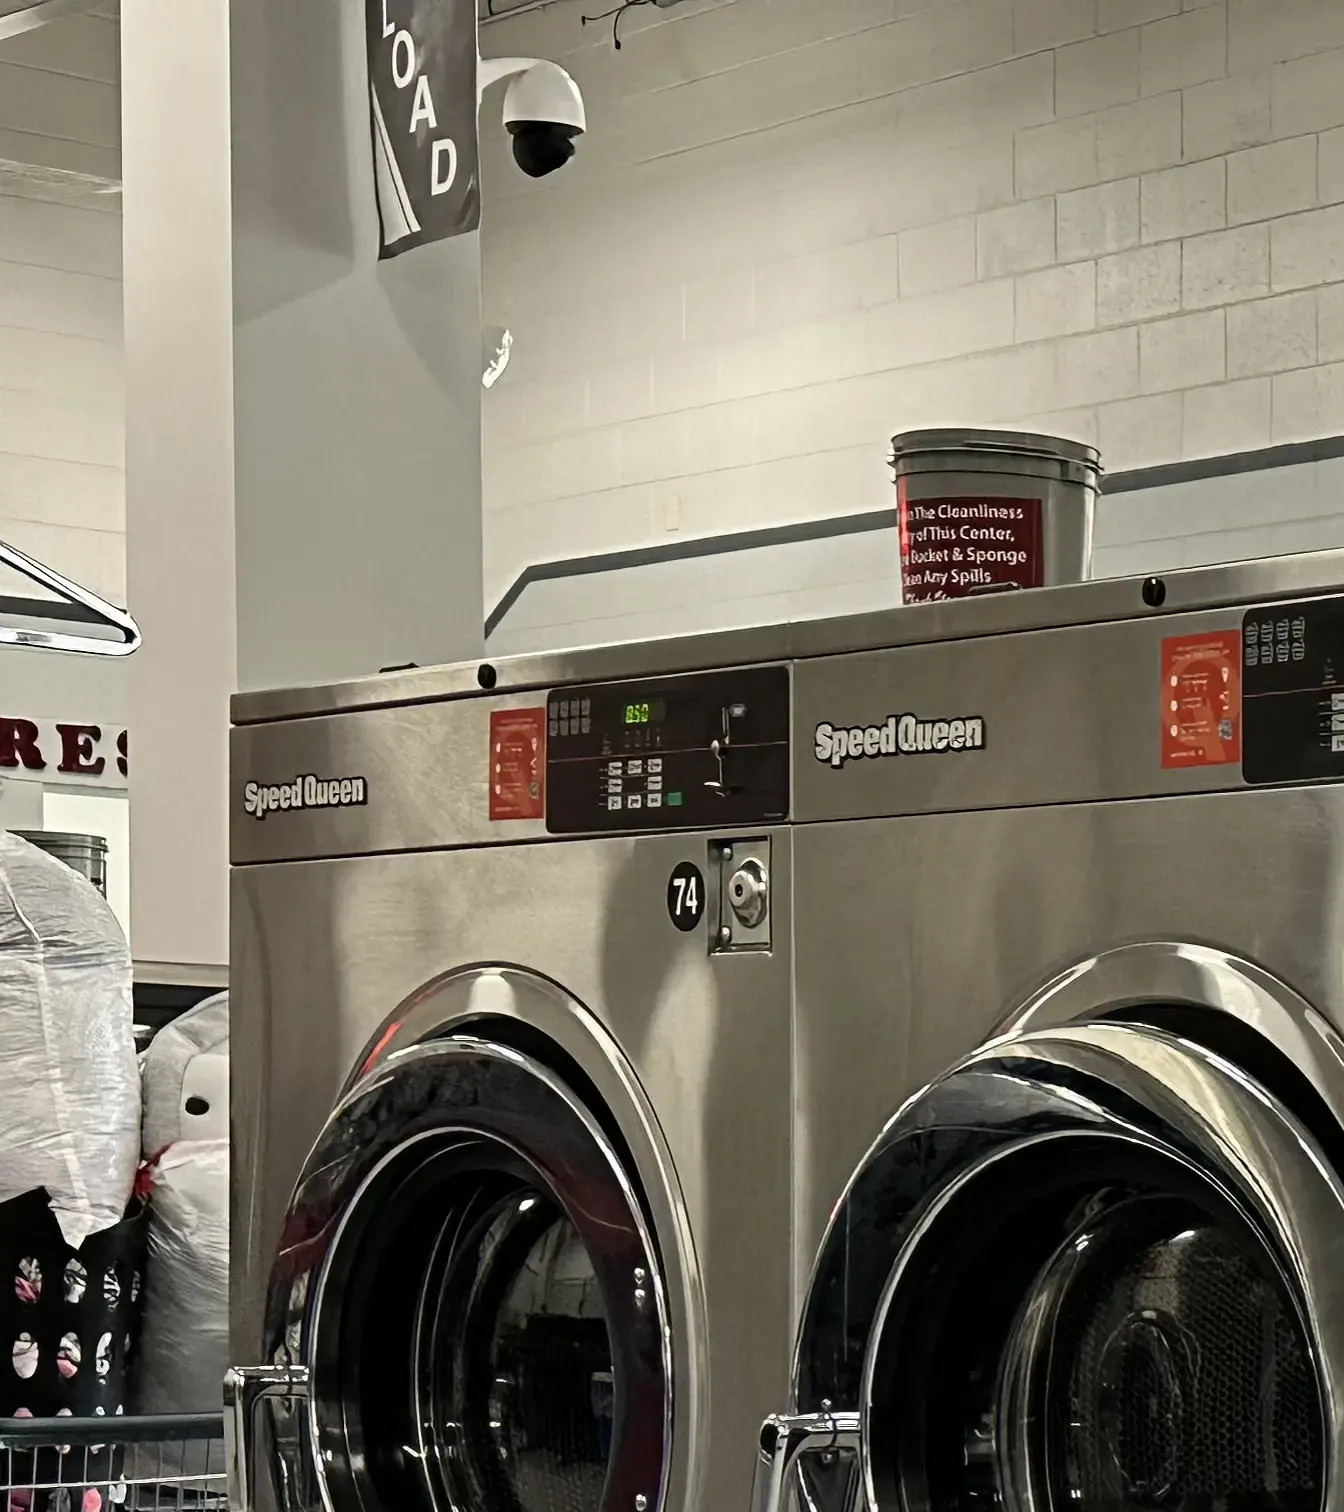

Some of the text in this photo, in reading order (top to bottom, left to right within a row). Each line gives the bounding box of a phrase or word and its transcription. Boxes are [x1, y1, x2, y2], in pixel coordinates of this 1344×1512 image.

[938, 504, 1024, 519] Cleanliness
[960, 525, 1015, 543] Center,
[952, 547, 963, 561] &
[967, 547, 1027, 566] Sponge
[951, 568, 992, 586] Spills
[0, 717, 128, 778] RE
[814, 714, 983, 765] Speed Queen
[244, 775, 366, 817] Speed Queen
[673, 877, 698, 915] 74
